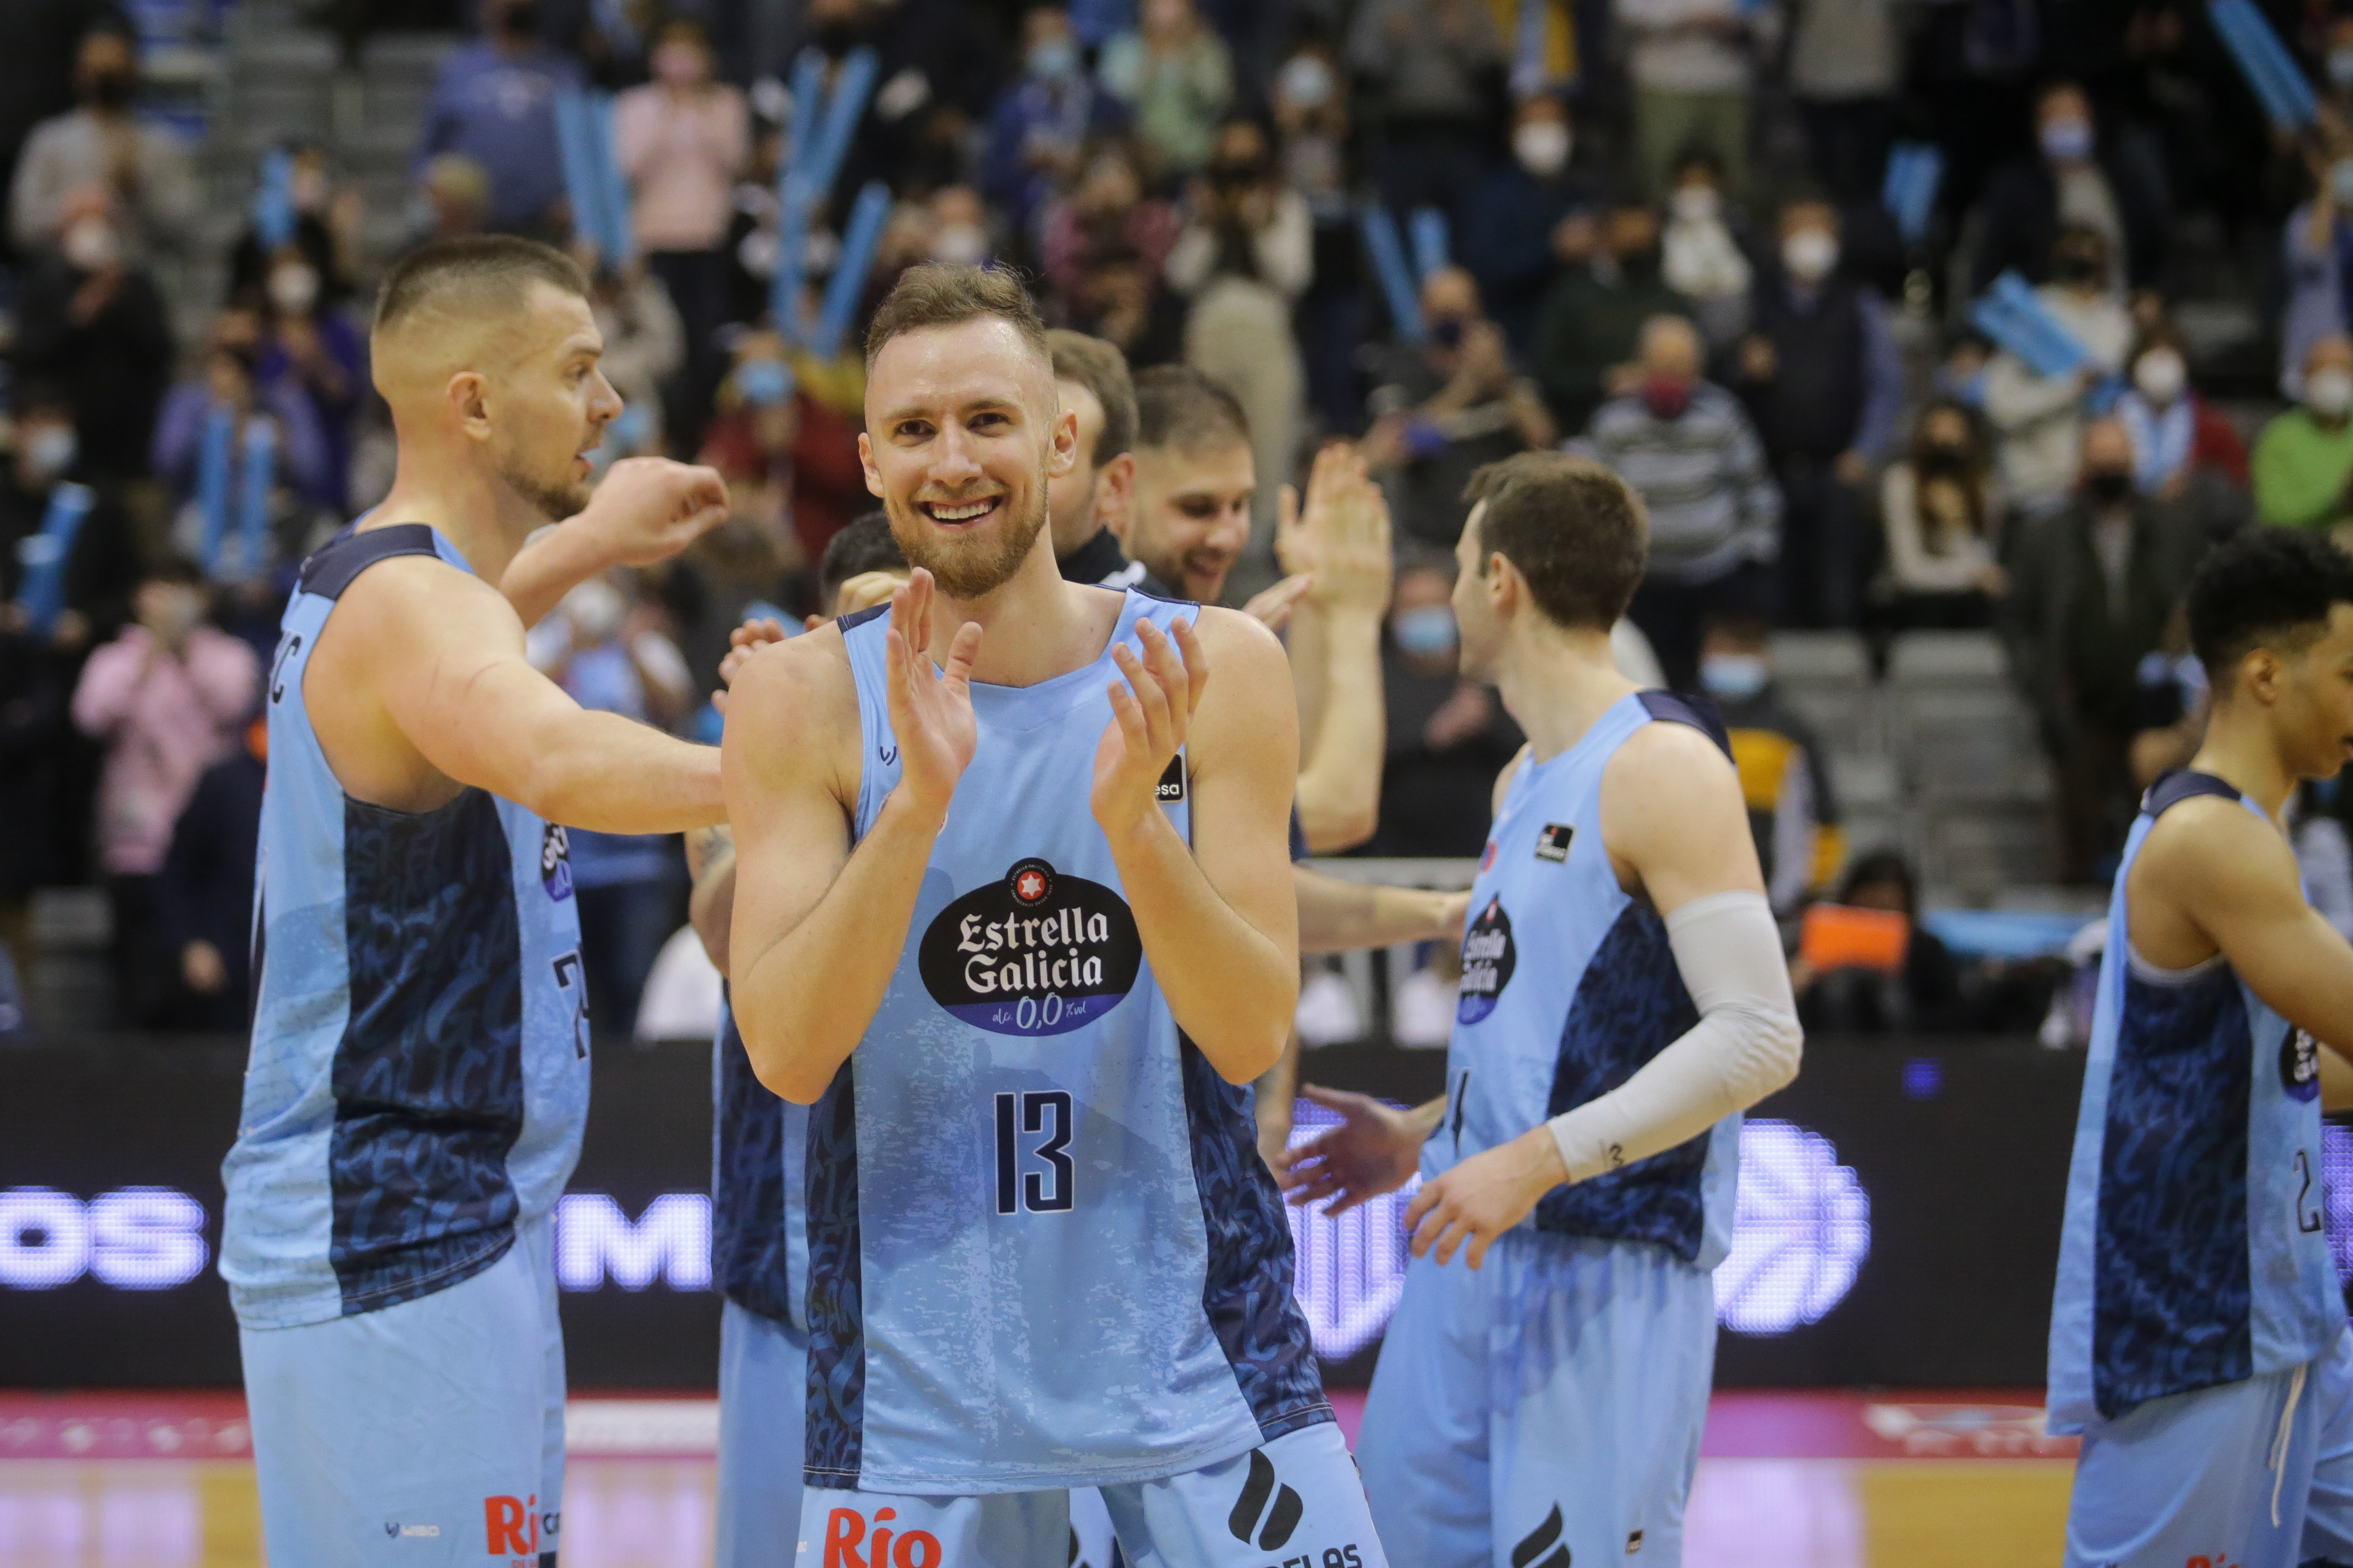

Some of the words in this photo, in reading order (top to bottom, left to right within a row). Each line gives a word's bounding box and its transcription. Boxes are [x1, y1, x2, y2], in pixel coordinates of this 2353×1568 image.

[957, 907, 1109, 952] Estrella
[964, 948, 1104, 993] Galicia
[1016, 992, 1063, 1029] 0,0
[994, 1090, 1074, 1216] 13
[823, 1506, 942, 1568] Río
